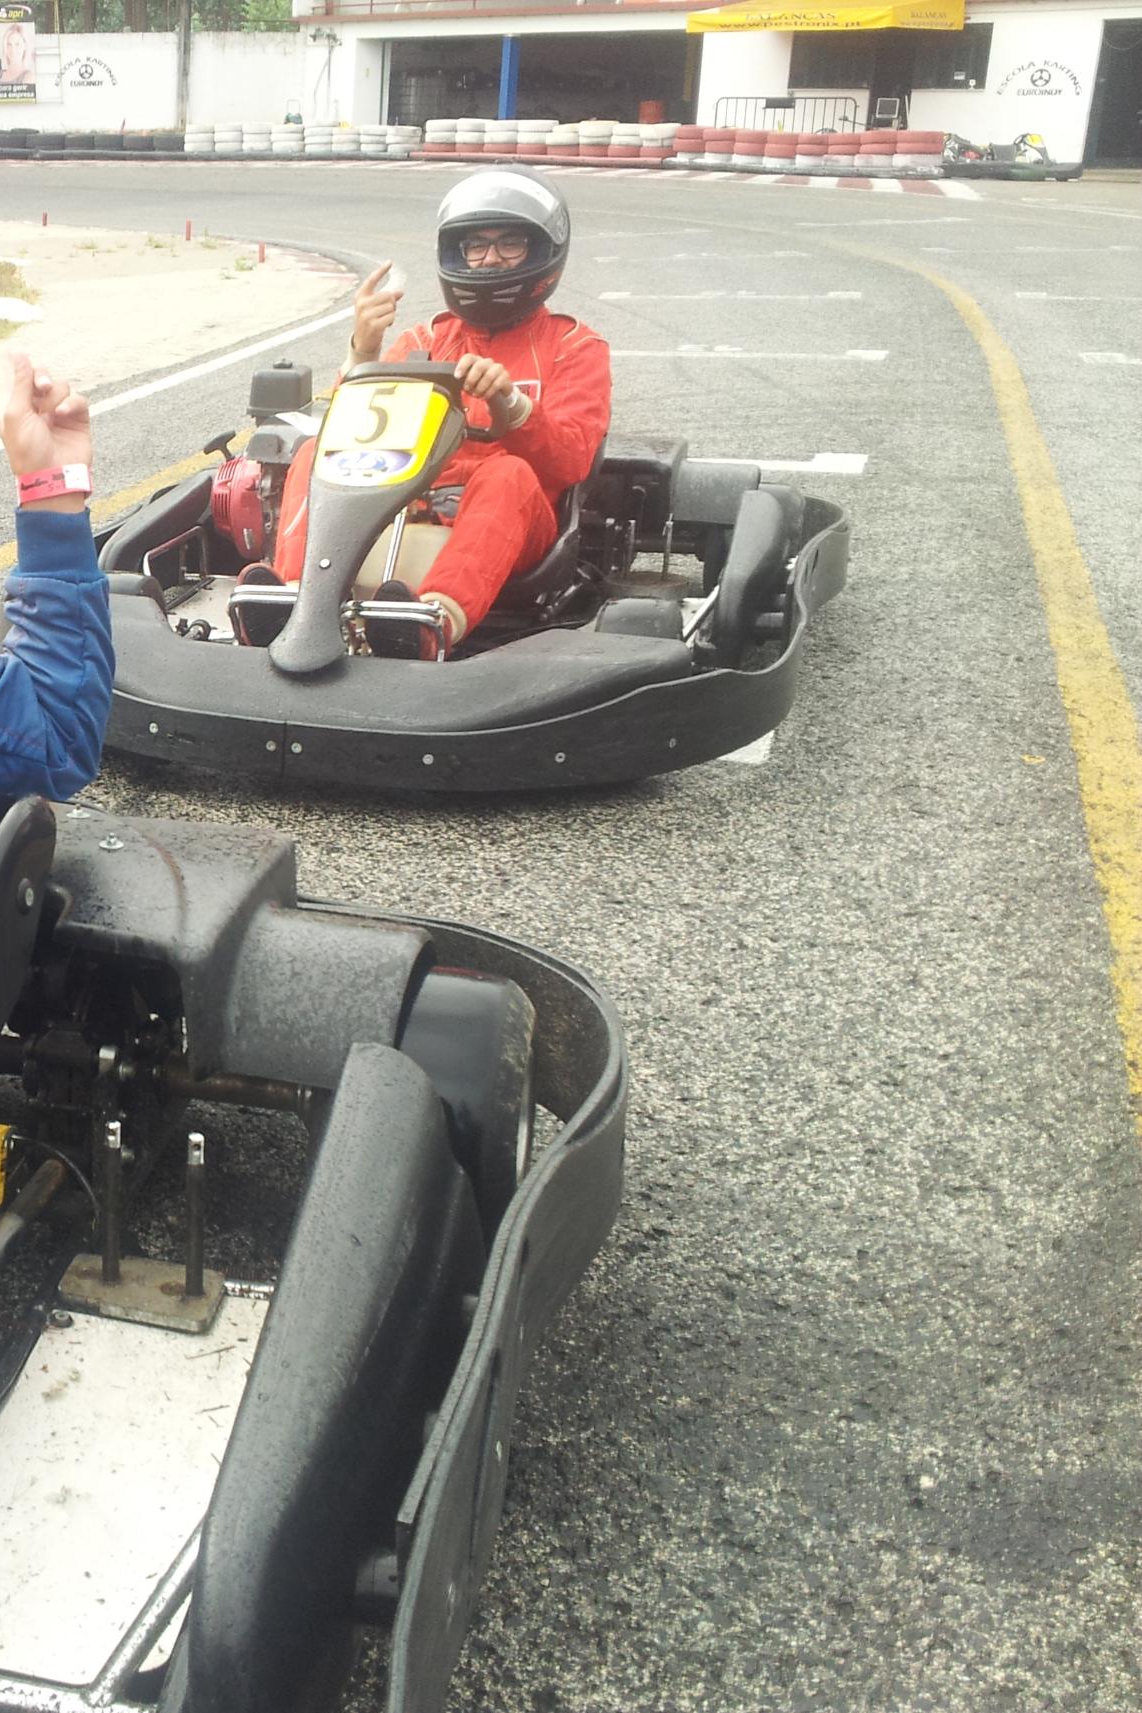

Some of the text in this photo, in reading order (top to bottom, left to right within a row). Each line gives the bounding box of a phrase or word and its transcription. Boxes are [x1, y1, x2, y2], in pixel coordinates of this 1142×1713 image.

[996, 60, 1082, 96] ESCOLA KARTING
[1017, 88, 1062, 96] EUROINDY
[354, 384, 400, 445] 5
